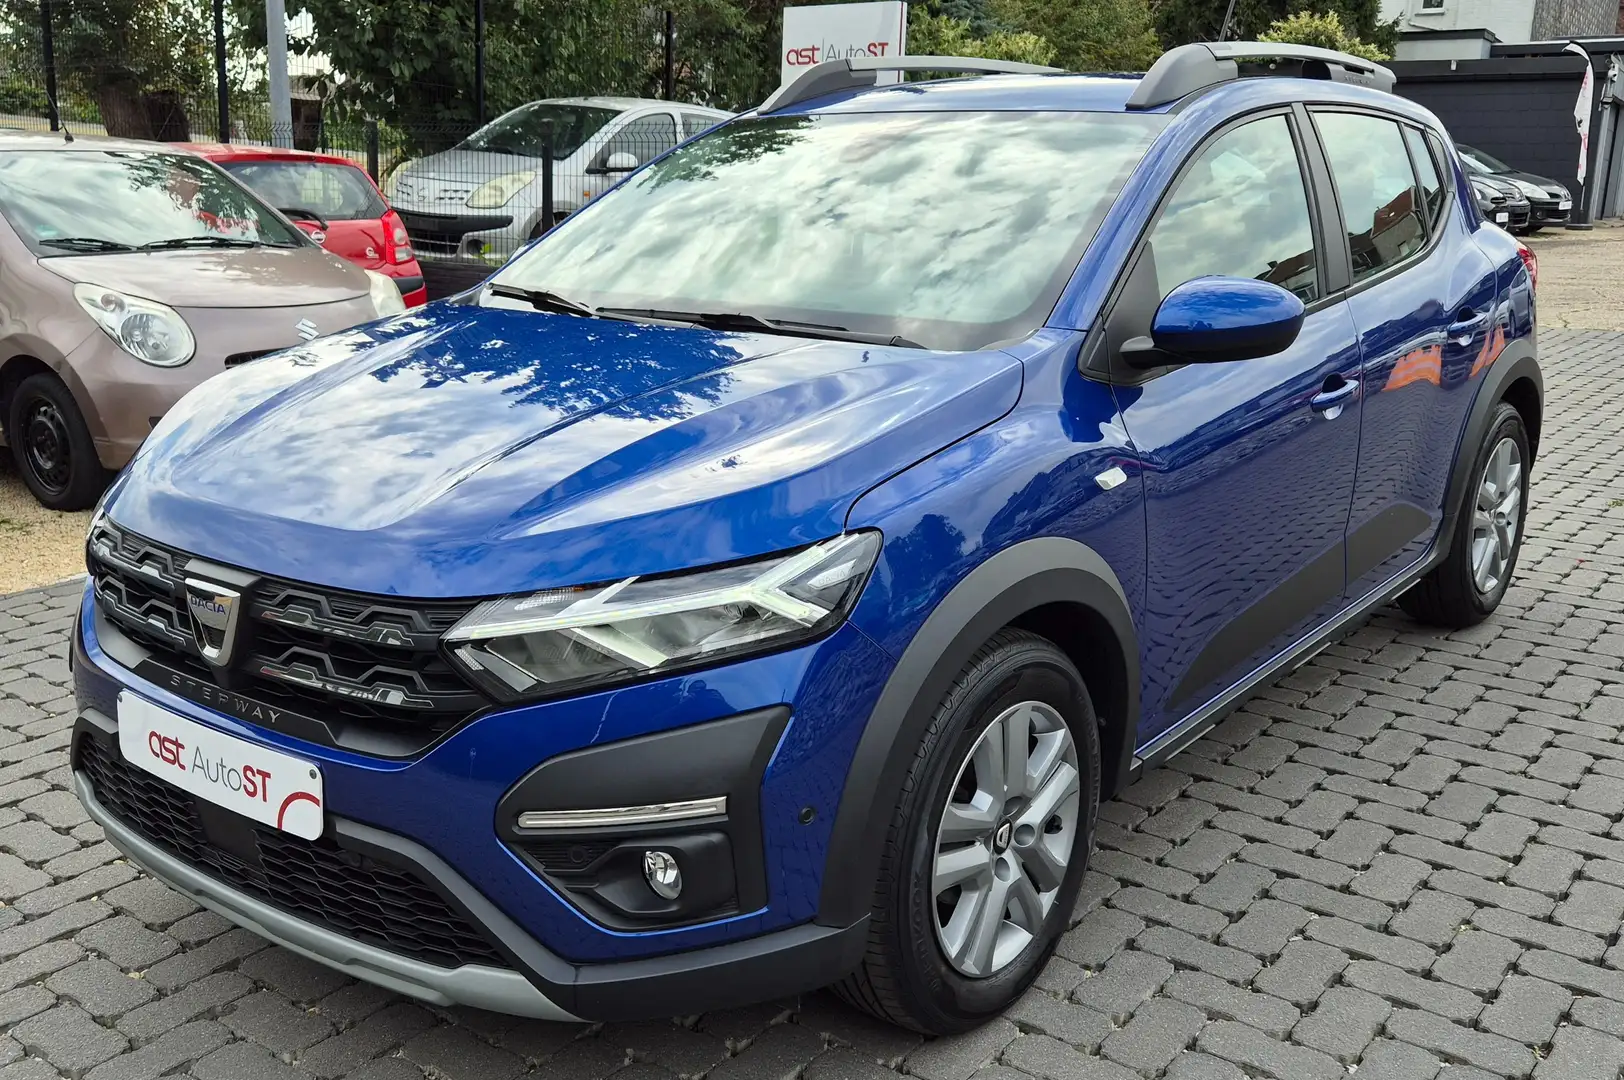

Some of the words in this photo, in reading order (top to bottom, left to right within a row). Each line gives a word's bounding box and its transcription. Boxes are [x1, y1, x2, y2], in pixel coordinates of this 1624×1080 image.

[190, 595, 226, 615] DACIA
[170, 674, 281, 724] STEPWAY
[148, 730, 186, 771] ast
[191, 745, 272, 803] AutoST
